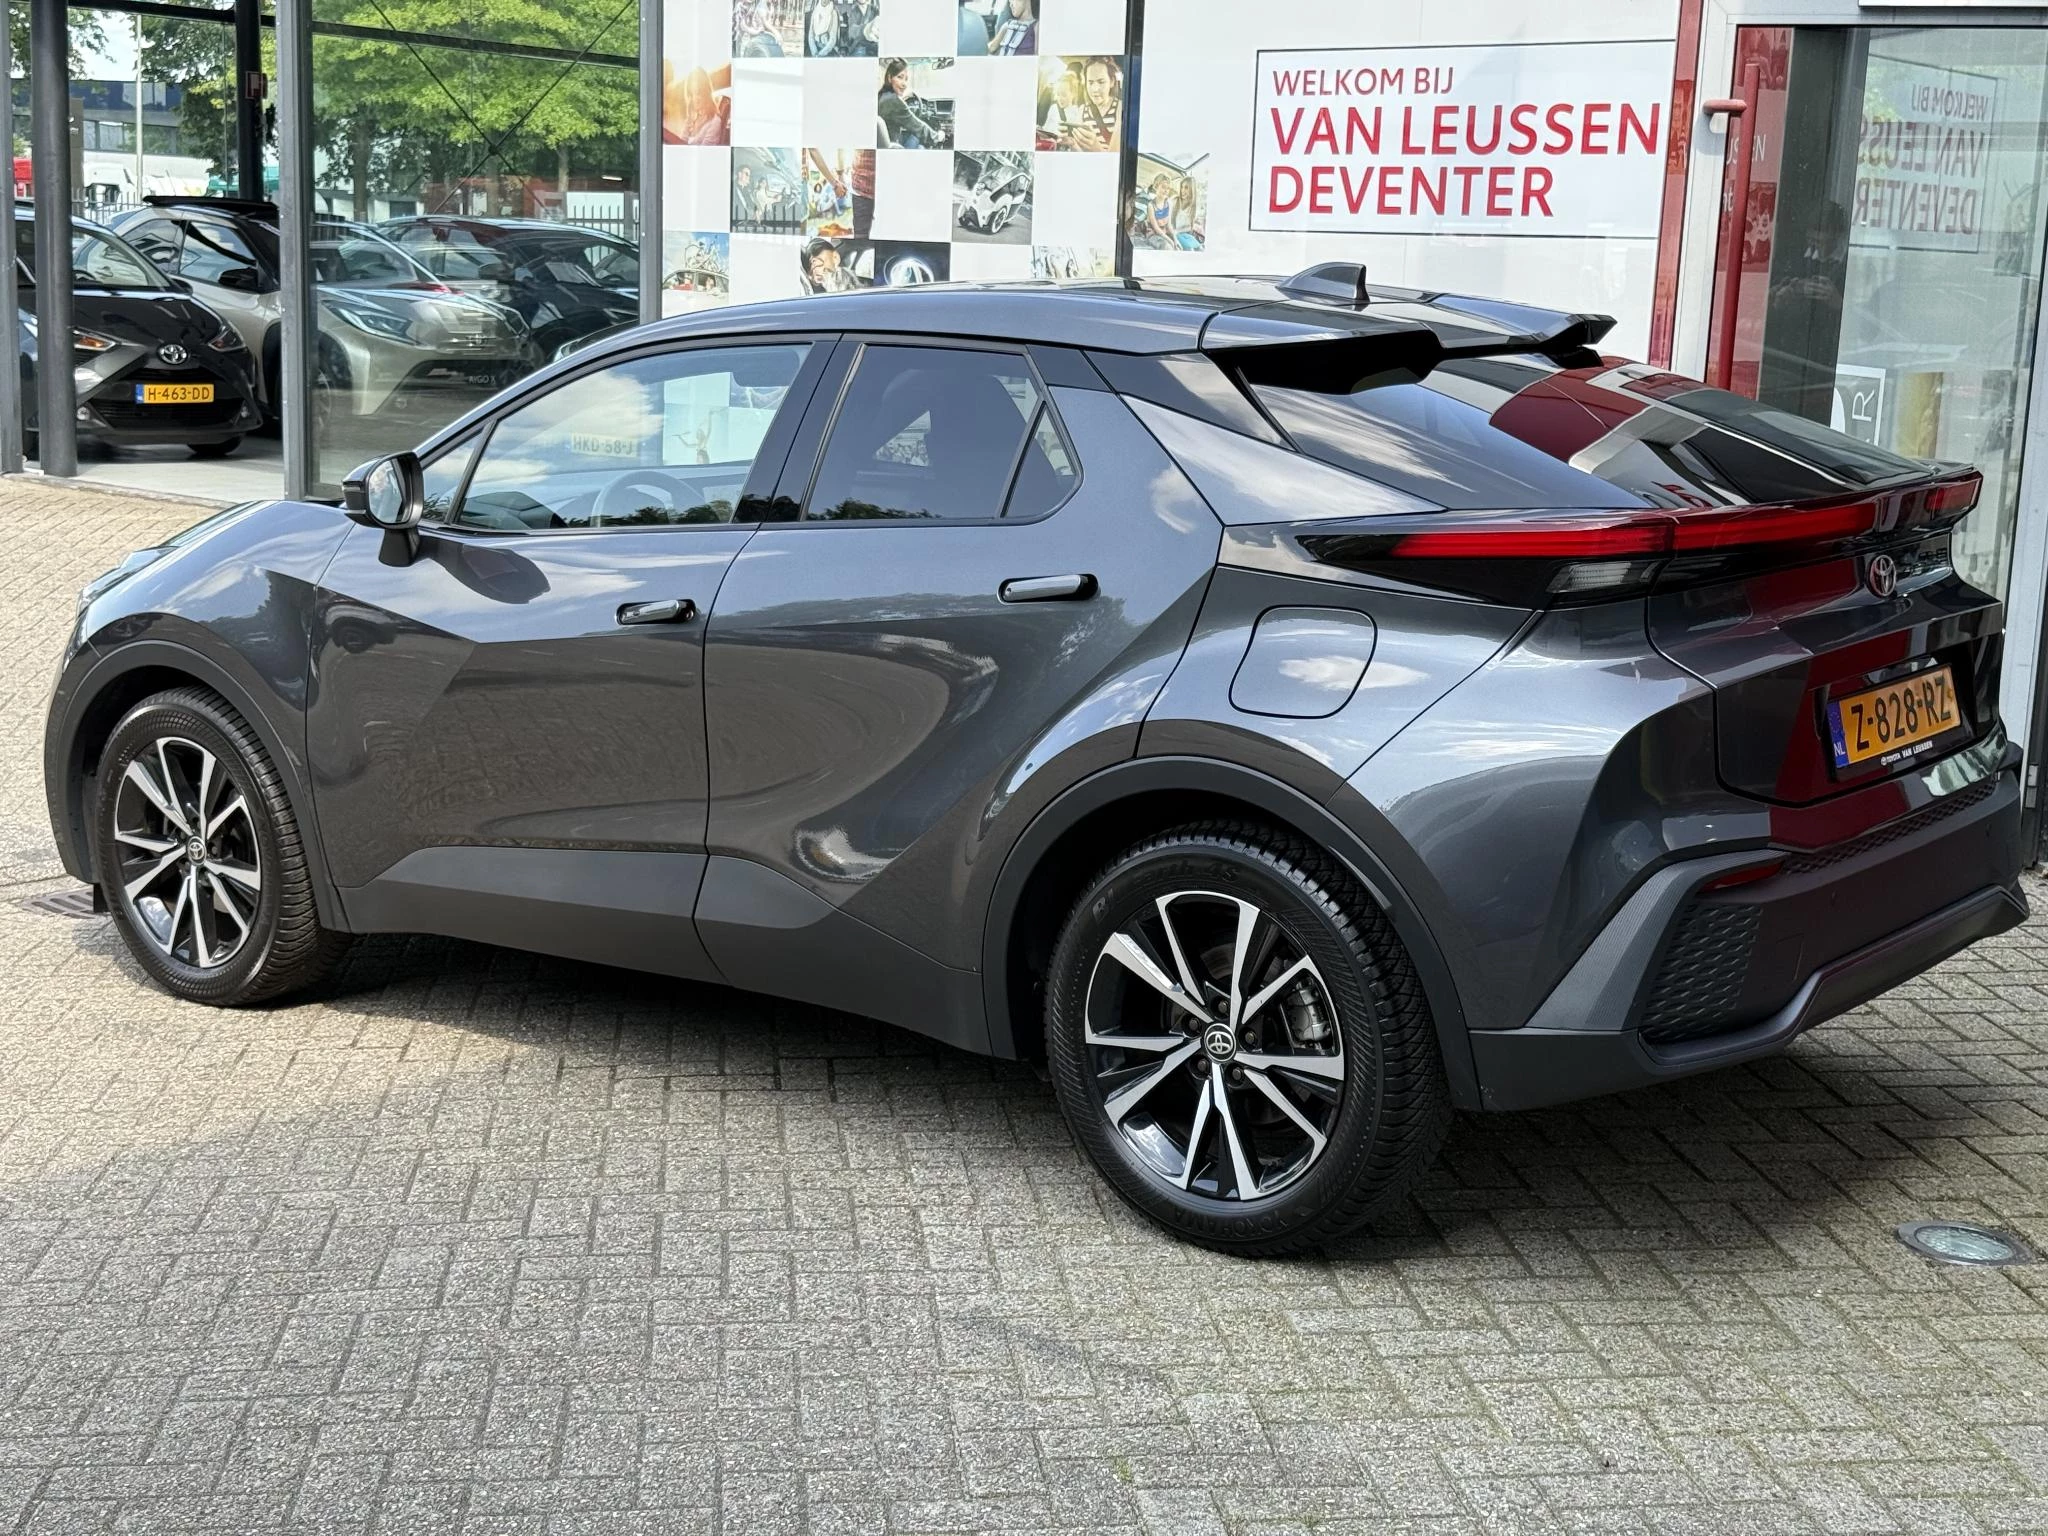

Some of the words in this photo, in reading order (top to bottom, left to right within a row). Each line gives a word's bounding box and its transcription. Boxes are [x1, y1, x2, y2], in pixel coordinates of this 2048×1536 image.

[1272, 67, 1404, 96] WELKOM
[1414, 66, 1454, 95] BIJ
[1270, 106, 1383, 156] VAN
[1401, 103, 1661, 156] LEUSSEN
[1268, 165, 1554, 218] DEVENTER
[147, 386, 210, 401] H-463-DD
[1850, 673, 1952, 753] Z-828-RZ
[1833, 741, 1846, 757] NL
